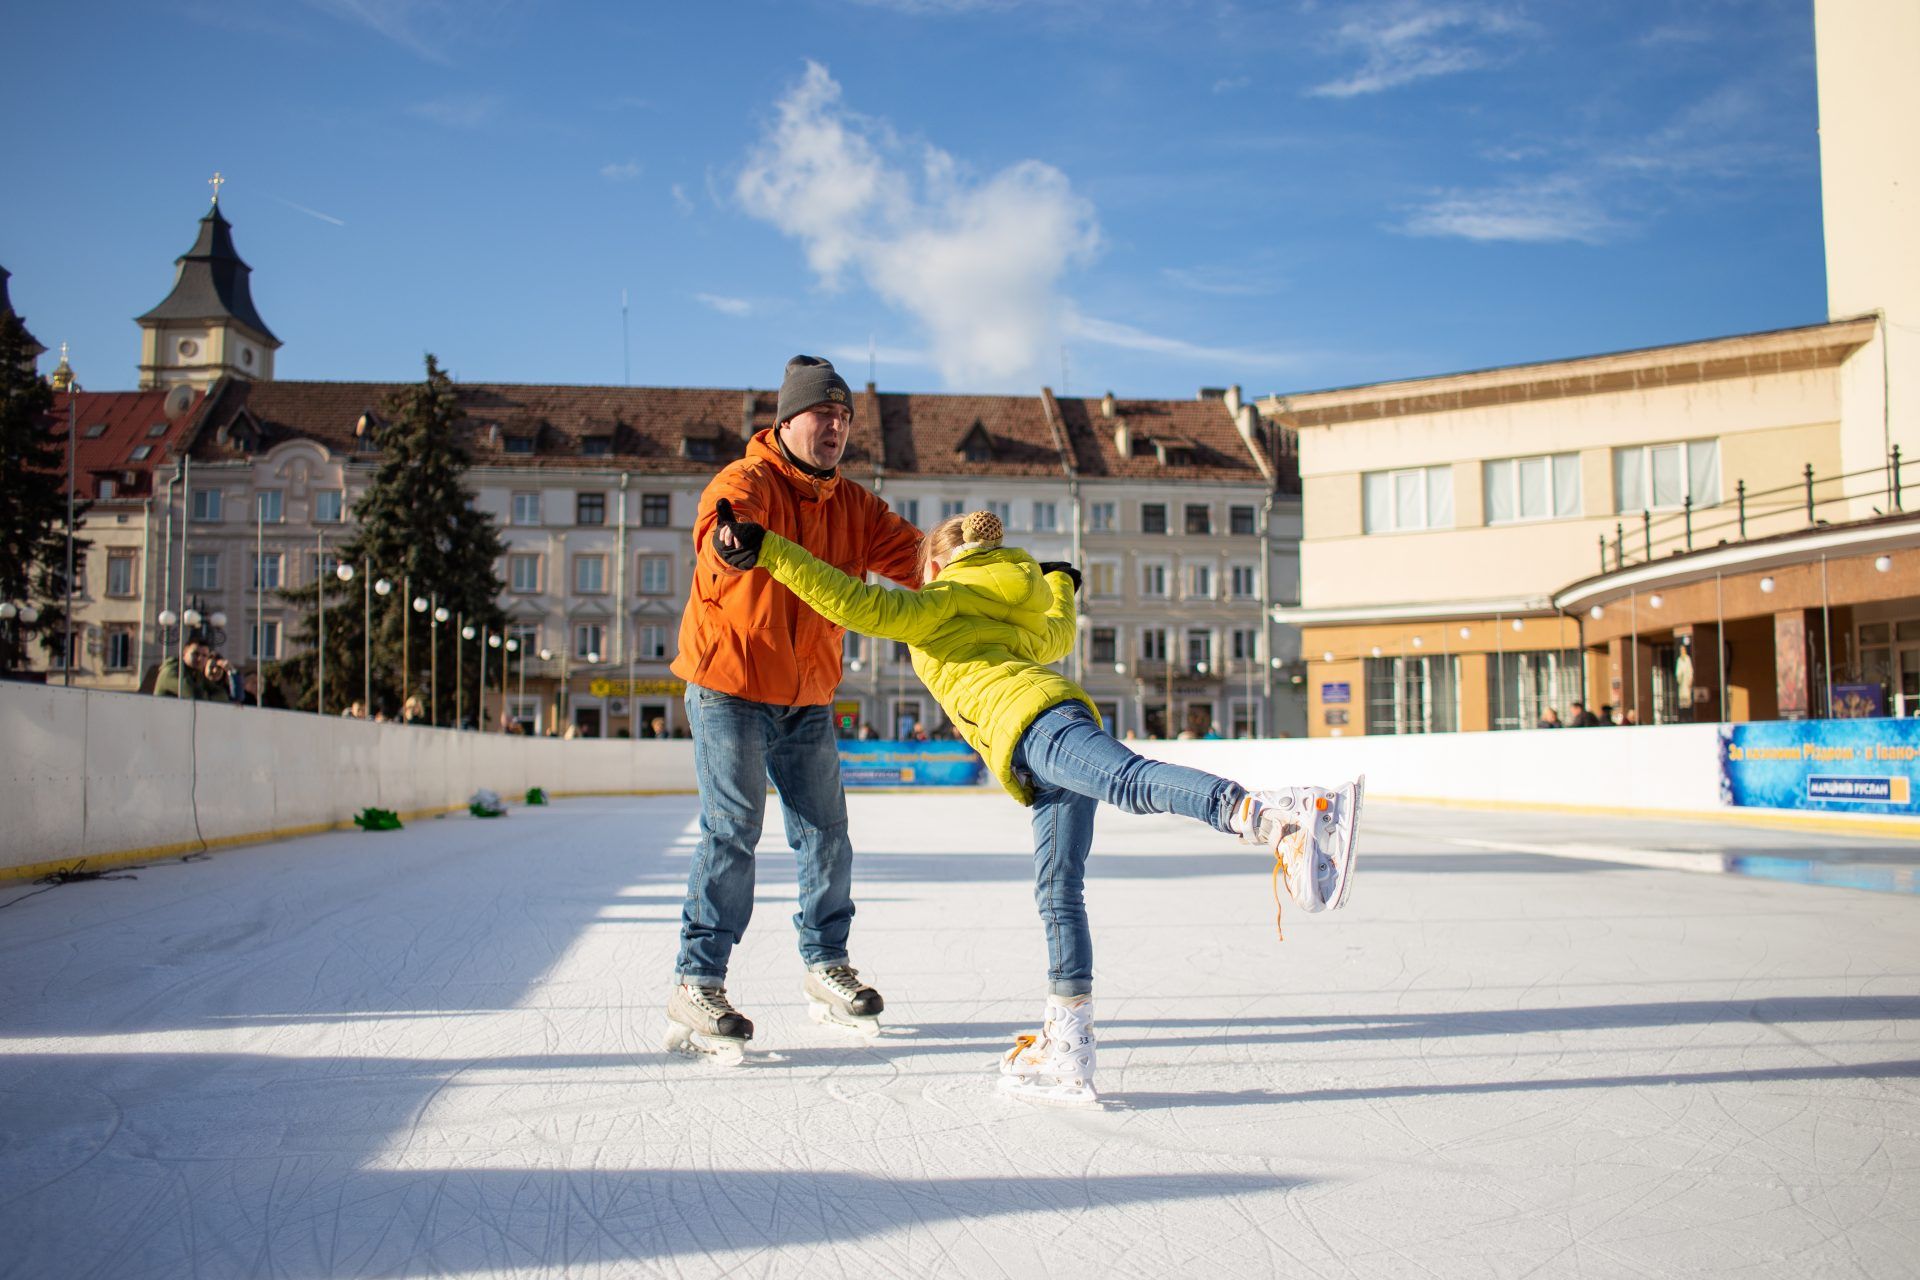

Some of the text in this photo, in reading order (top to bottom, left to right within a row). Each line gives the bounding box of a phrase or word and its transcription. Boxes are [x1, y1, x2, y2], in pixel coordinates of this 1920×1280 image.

[1729, 743, 1743, 761] За
[1876, 743, 1920, 761] Івано-
[1855, 783, 1888, 795] РУСЛАН
[1079, 1036, 1089, 1045] 33
